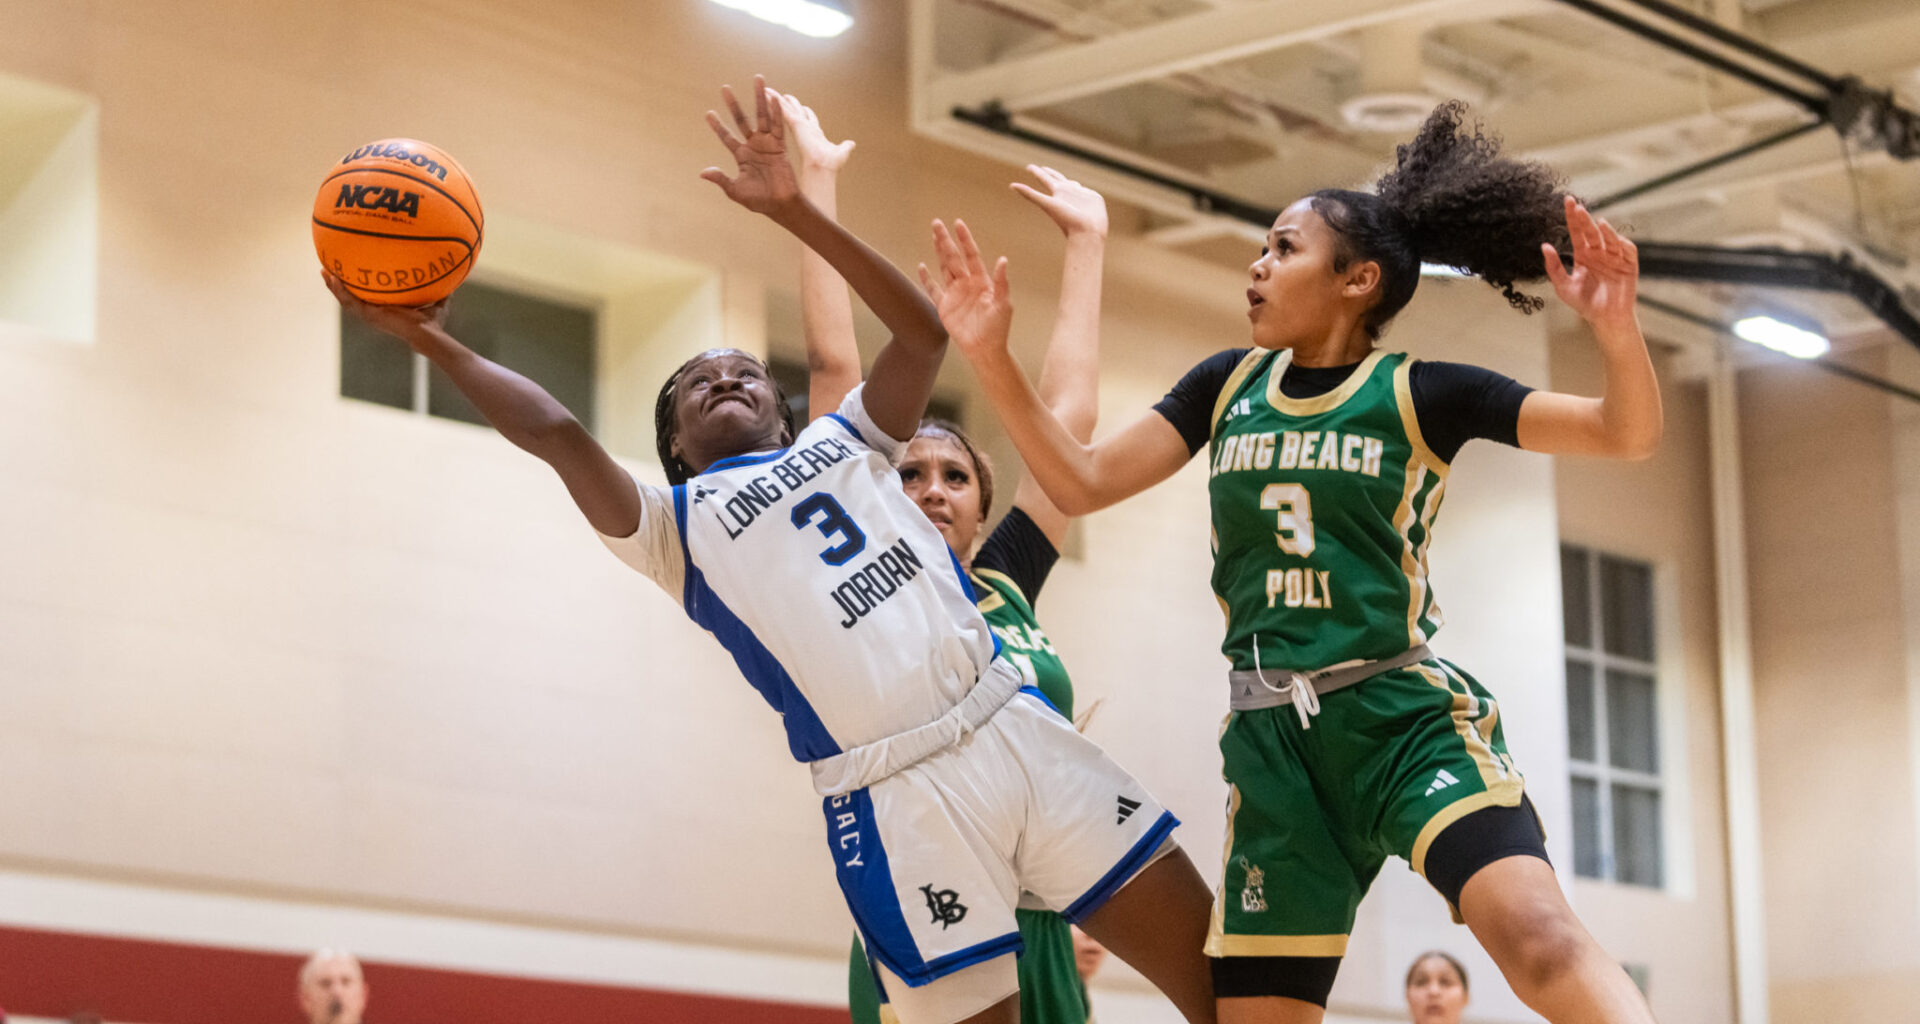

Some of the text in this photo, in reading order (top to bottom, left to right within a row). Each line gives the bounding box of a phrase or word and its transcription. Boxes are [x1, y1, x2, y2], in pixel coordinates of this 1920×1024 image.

[342, 143, 448, 182] Wilson
[335, 184, 421, 218] NCAA
[357, 251, 457, 287] JORDAN
[1211, 430, 1384, 479] LONG BEACH
[716, 437, 859, 541] LONG BEACH
[791, 491, 867, 566] 3
[1260, 482, 1316, 559] 3
[830, 537, 924, 629] JORDAN
[1265, 567, 1332, 609] POLY
